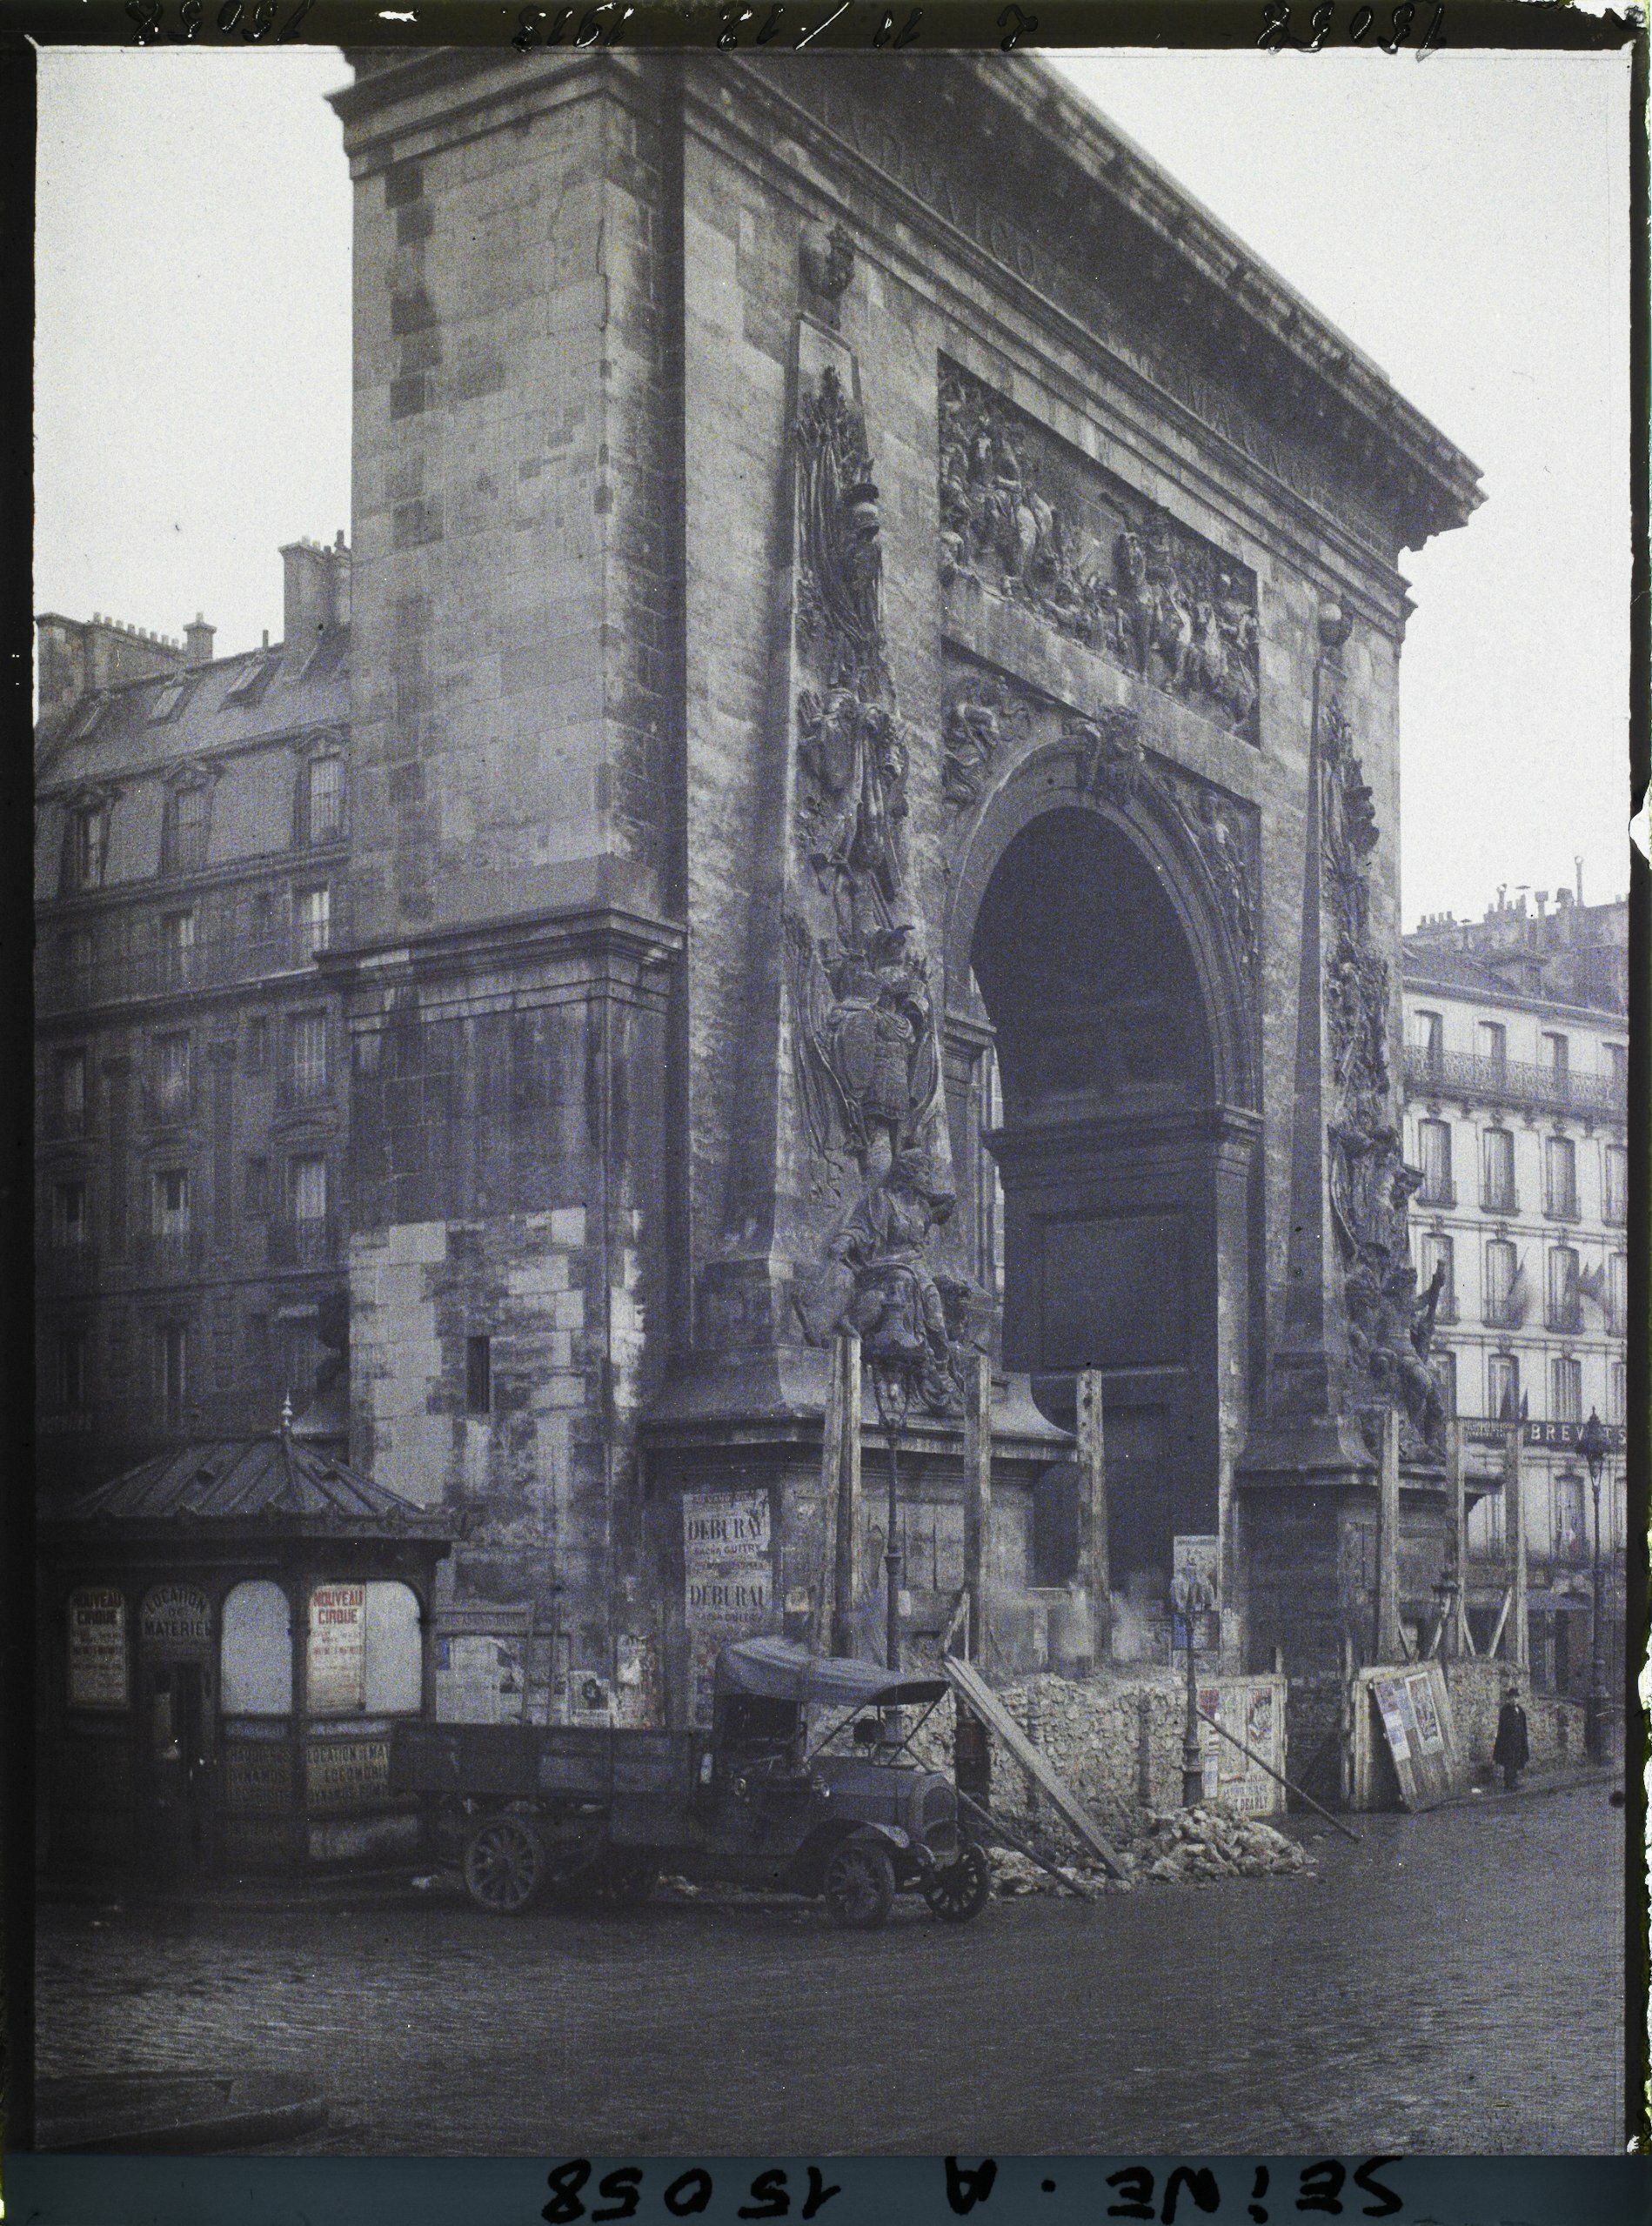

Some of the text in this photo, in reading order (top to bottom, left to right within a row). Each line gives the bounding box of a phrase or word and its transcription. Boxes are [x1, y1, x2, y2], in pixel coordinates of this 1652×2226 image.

[1256, 2, 1447, 59] 15058
[1531, 1423, 1628, 1444] BREVTS
[146, 1587, 207, 1614] LOCATION
[314, 1590, 364, 1607] NOUVEAU
[318, 1608, 358, 1624] CIRQUE
[541, 2159, 840, 2223] 15058
[943, 2156, 997, 2215] A
